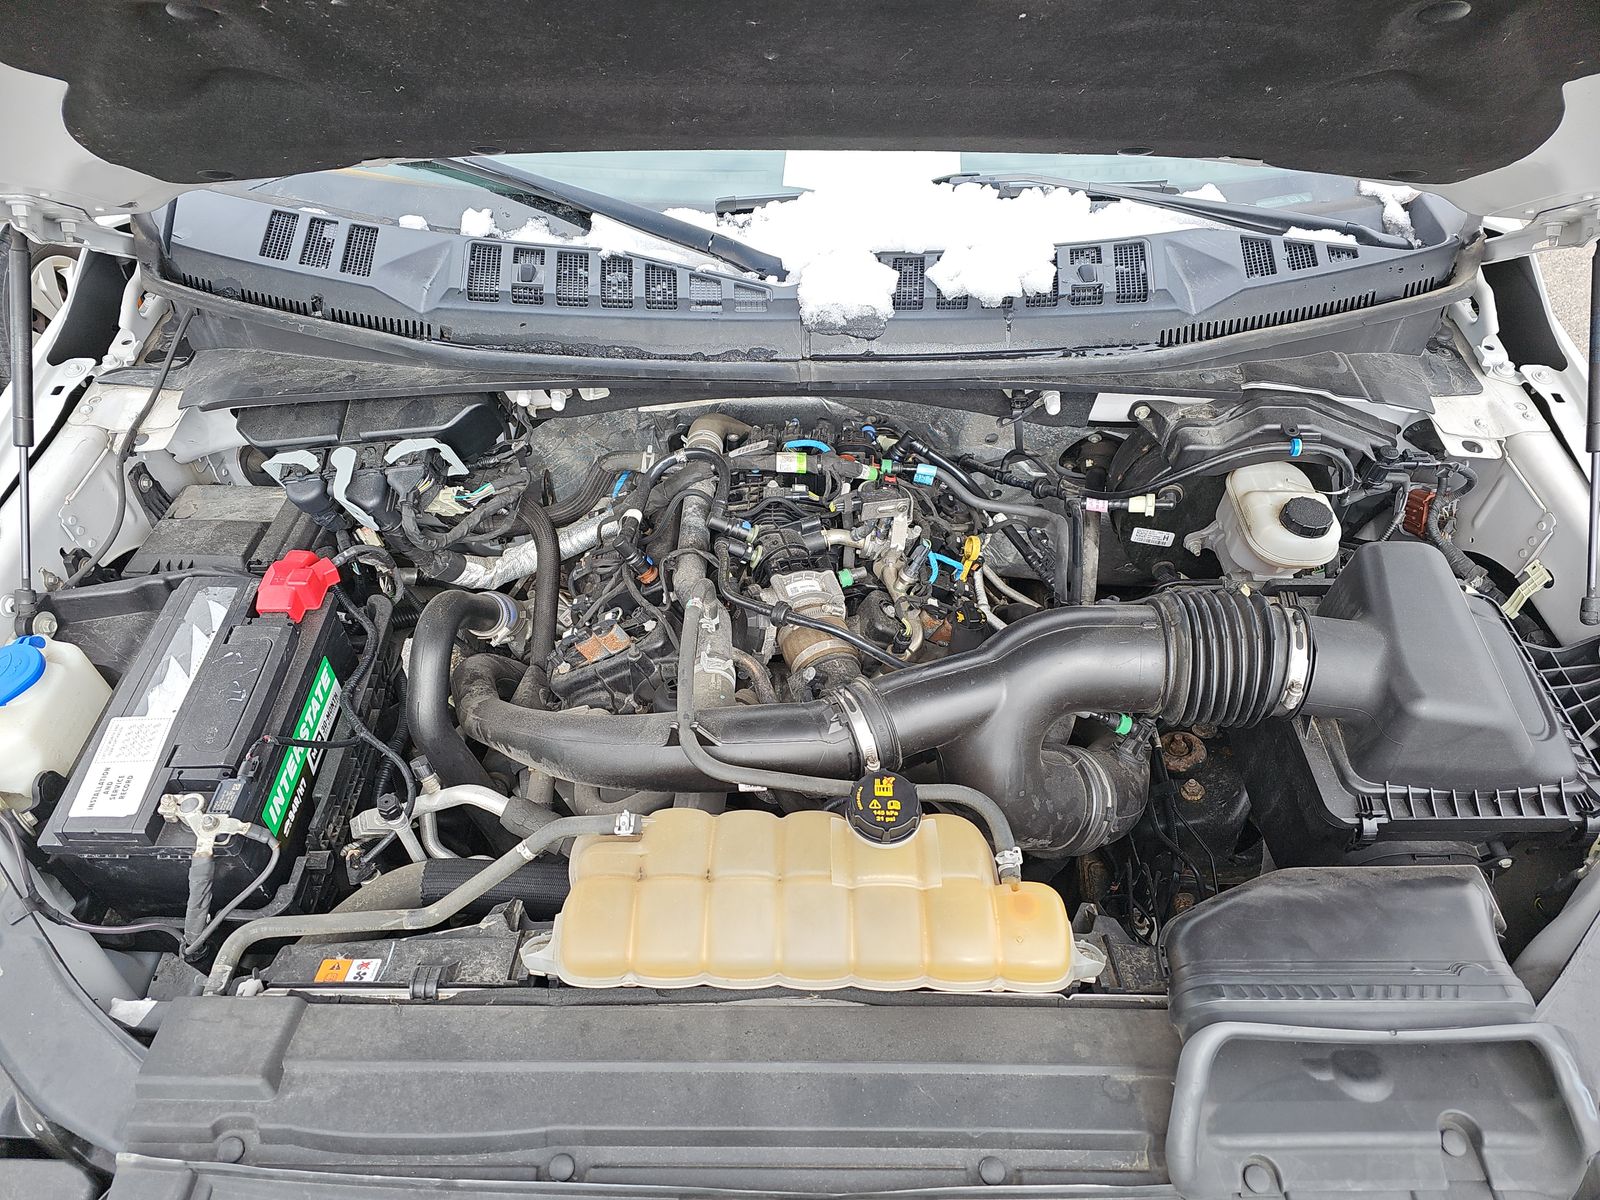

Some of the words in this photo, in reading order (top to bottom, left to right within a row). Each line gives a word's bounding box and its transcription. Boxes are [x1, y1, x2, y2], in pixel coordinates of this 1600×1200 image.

[87, 766, 111, 811] INSTALLATION
[103, 781, 113, 795] AND
[109, 775, 125, 801] SERVICE
[118, 775, 134, 800] RECORD
